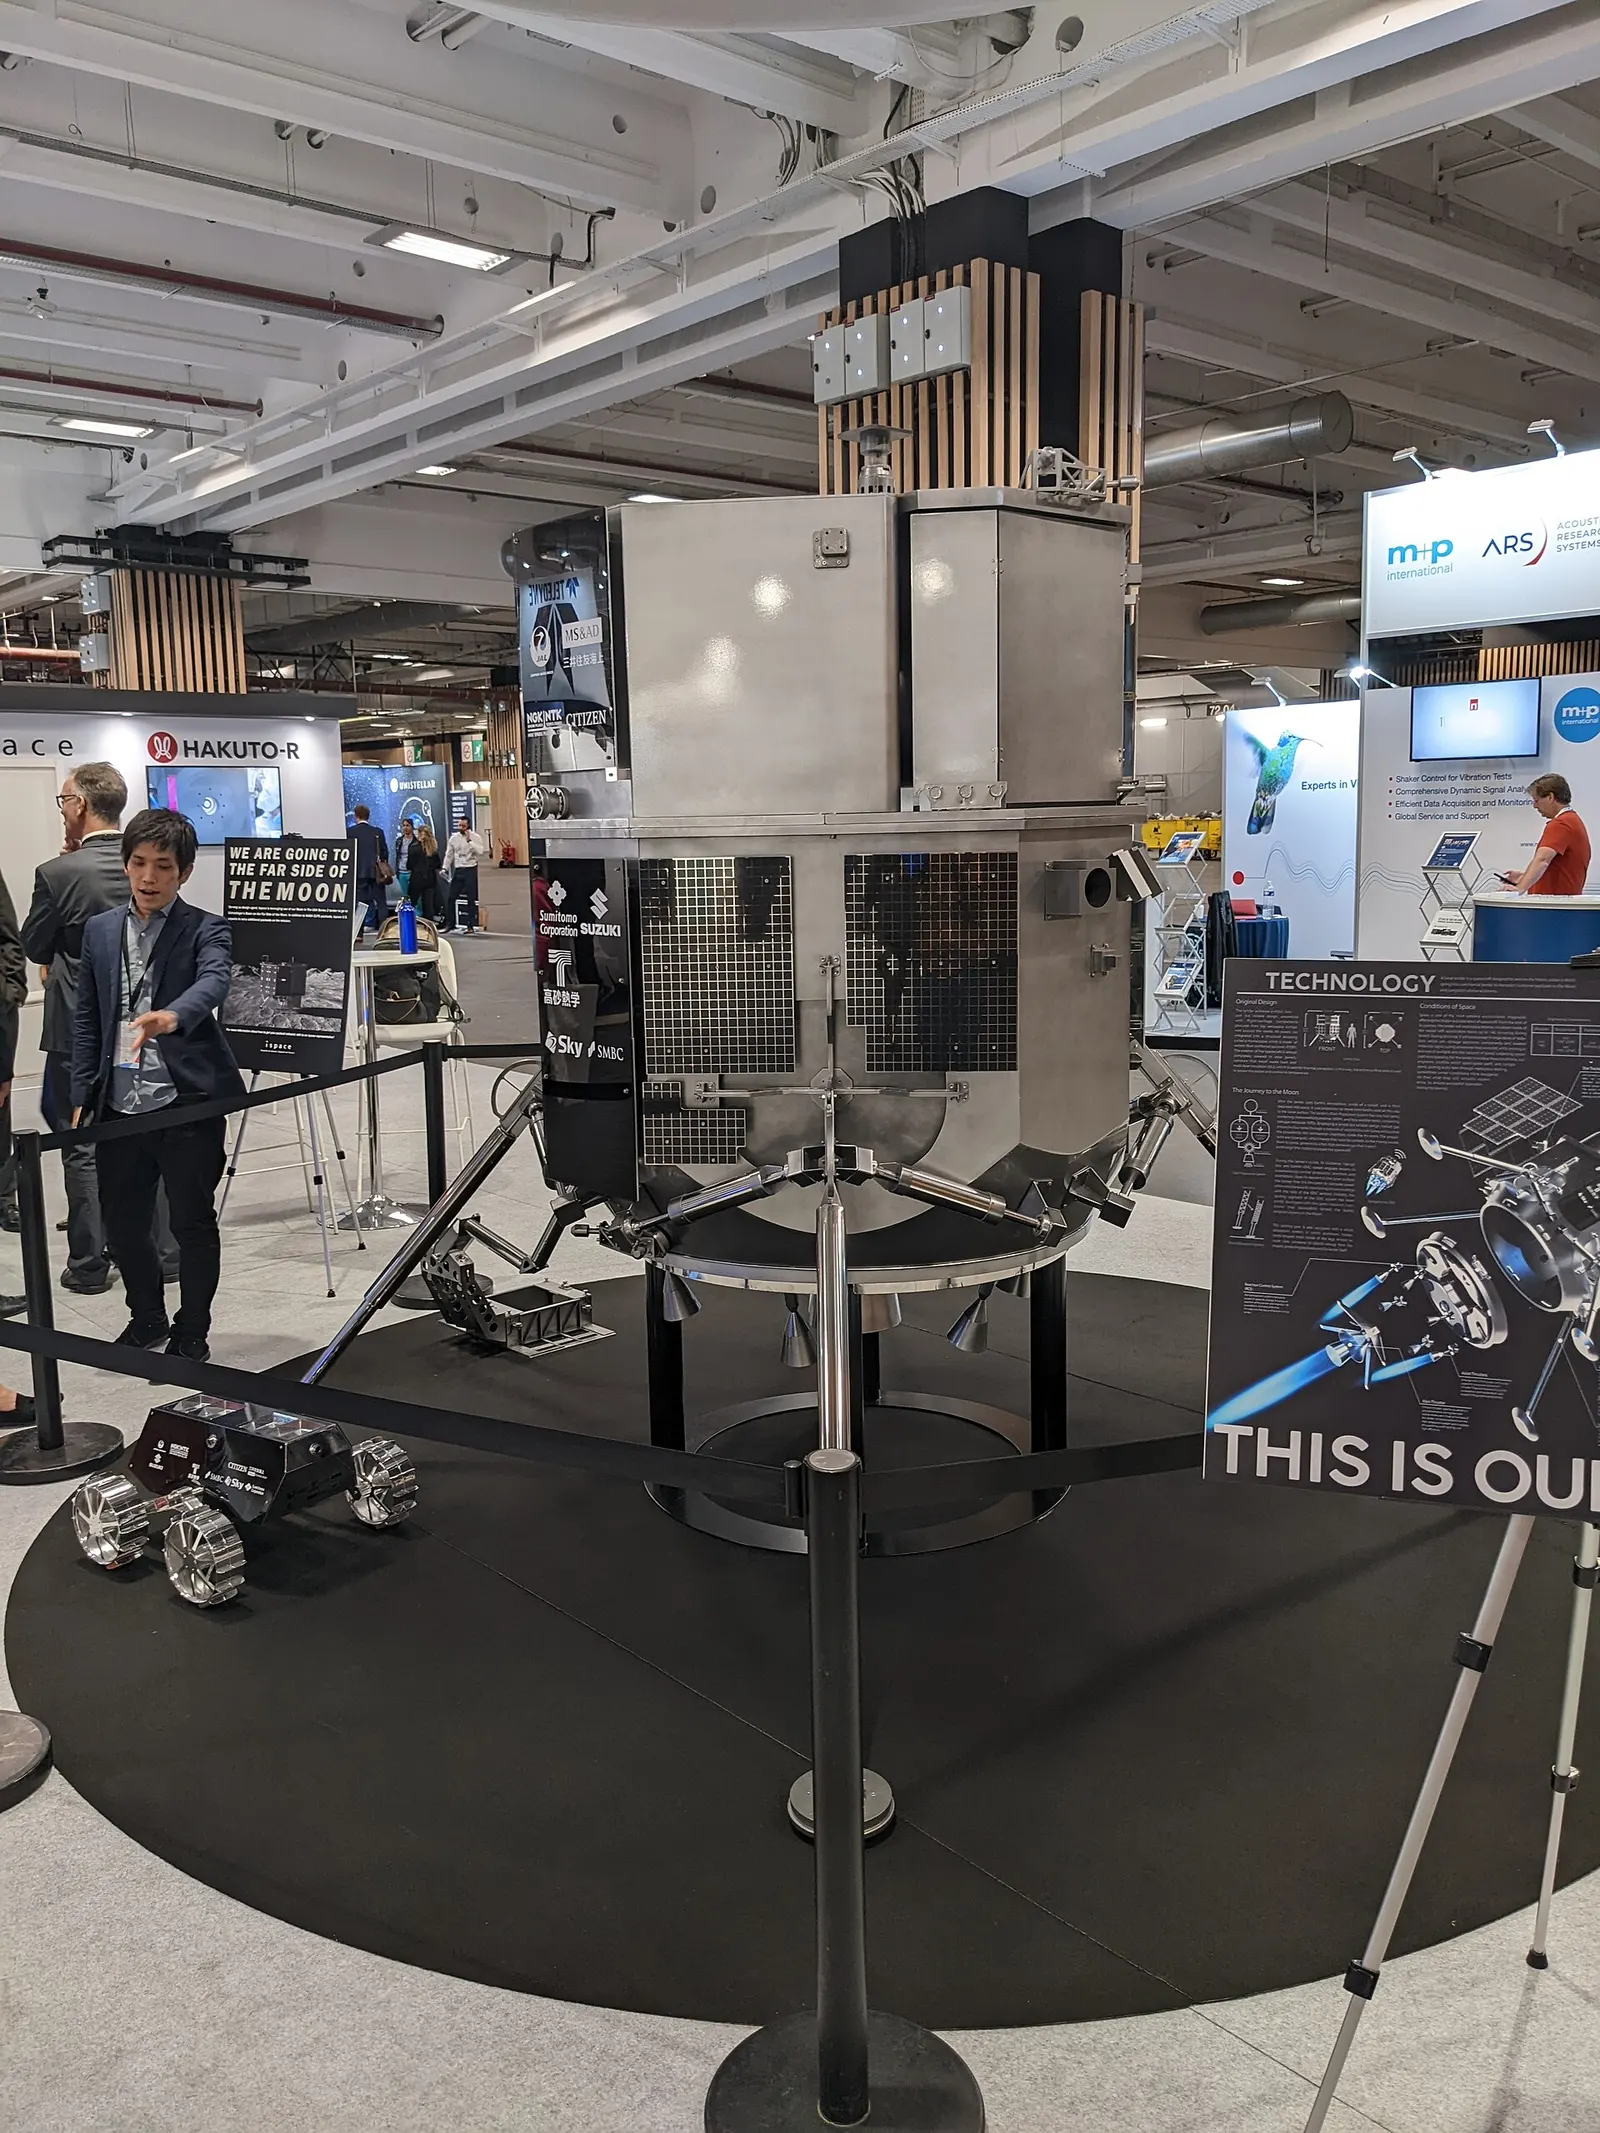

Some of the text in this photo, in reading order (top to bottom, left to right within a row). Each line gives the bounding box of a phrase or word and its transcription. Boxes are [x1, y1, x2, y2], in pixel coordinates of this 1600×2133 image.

[1388, 538, 1454, 565] m+p
[1482, 532, 1534, 558] ARS
[1387, 564, 1454, 581] international
[565, 624, 600, 642] MS&AD
[536, 654, 548, 663] JAL
[563, 651, 604, 668] 三井住友海上
[526, 709, 563, 724] NGK NTK
[566, 710, 607, 727] CITIZEN
[1562, 705, 1600, 718] m+p
[183, 740, 300, 759] HAKUTO-R
[399, 779, 436, 790] UNISTELLAR
[1395, 775, 1420, 783] Shaker
[1421, 774, 1447, 782] Control
[1459, 773, 1491, 781] Vibration
[1301, 781, 1337, 794] Experts
[1339, 780, 1348, 789] in
[1395, 787, 1449, 796] Comprehensive
[1450, 787, 1481, 795] Dynamic
[1483, 786, 1506, 795] Signal
[1395, 800, 1422, 808] Efficient
[1441, 799, 1481, 808] Acquisition
[1482, 799, 1496, 807] and
[1498, 798, 1534, 806] Monitorin
[1418, 812, 1444, 820] Service
[1461, 812, 1490, 821] Support
[229, 847, 350, 861] WE ARE GOING TO
[229, 863, 349, 878] THE FAR SIDE OF
[229, 881, 347, 903] THE MOON
[539, 910, 578, 924] Sumitomo
[539, 923, 578, 937] Corporation
[580, 922, 621, 937] SUZUKI
[1265, 971, 1436, 993] TECHNOLOGY
[543, 988, 581, 1008] 高砂熱学
[1235, 998, 1258, 1006] Original
[1458, 1003, 1476, 1011] Space
[265, 1040, 292, 1050] ispace
[557, 1034, 583, 1058] Sky
[597, 1044, 624, 1062] SMBC
[1213, 1423, 1370, 1487] THIS
[1391, 1440, 1454, 1496] IS
[227, 1461, 248, 1473] CITIZEN
[231, 1478, 244, 1490] Sky
